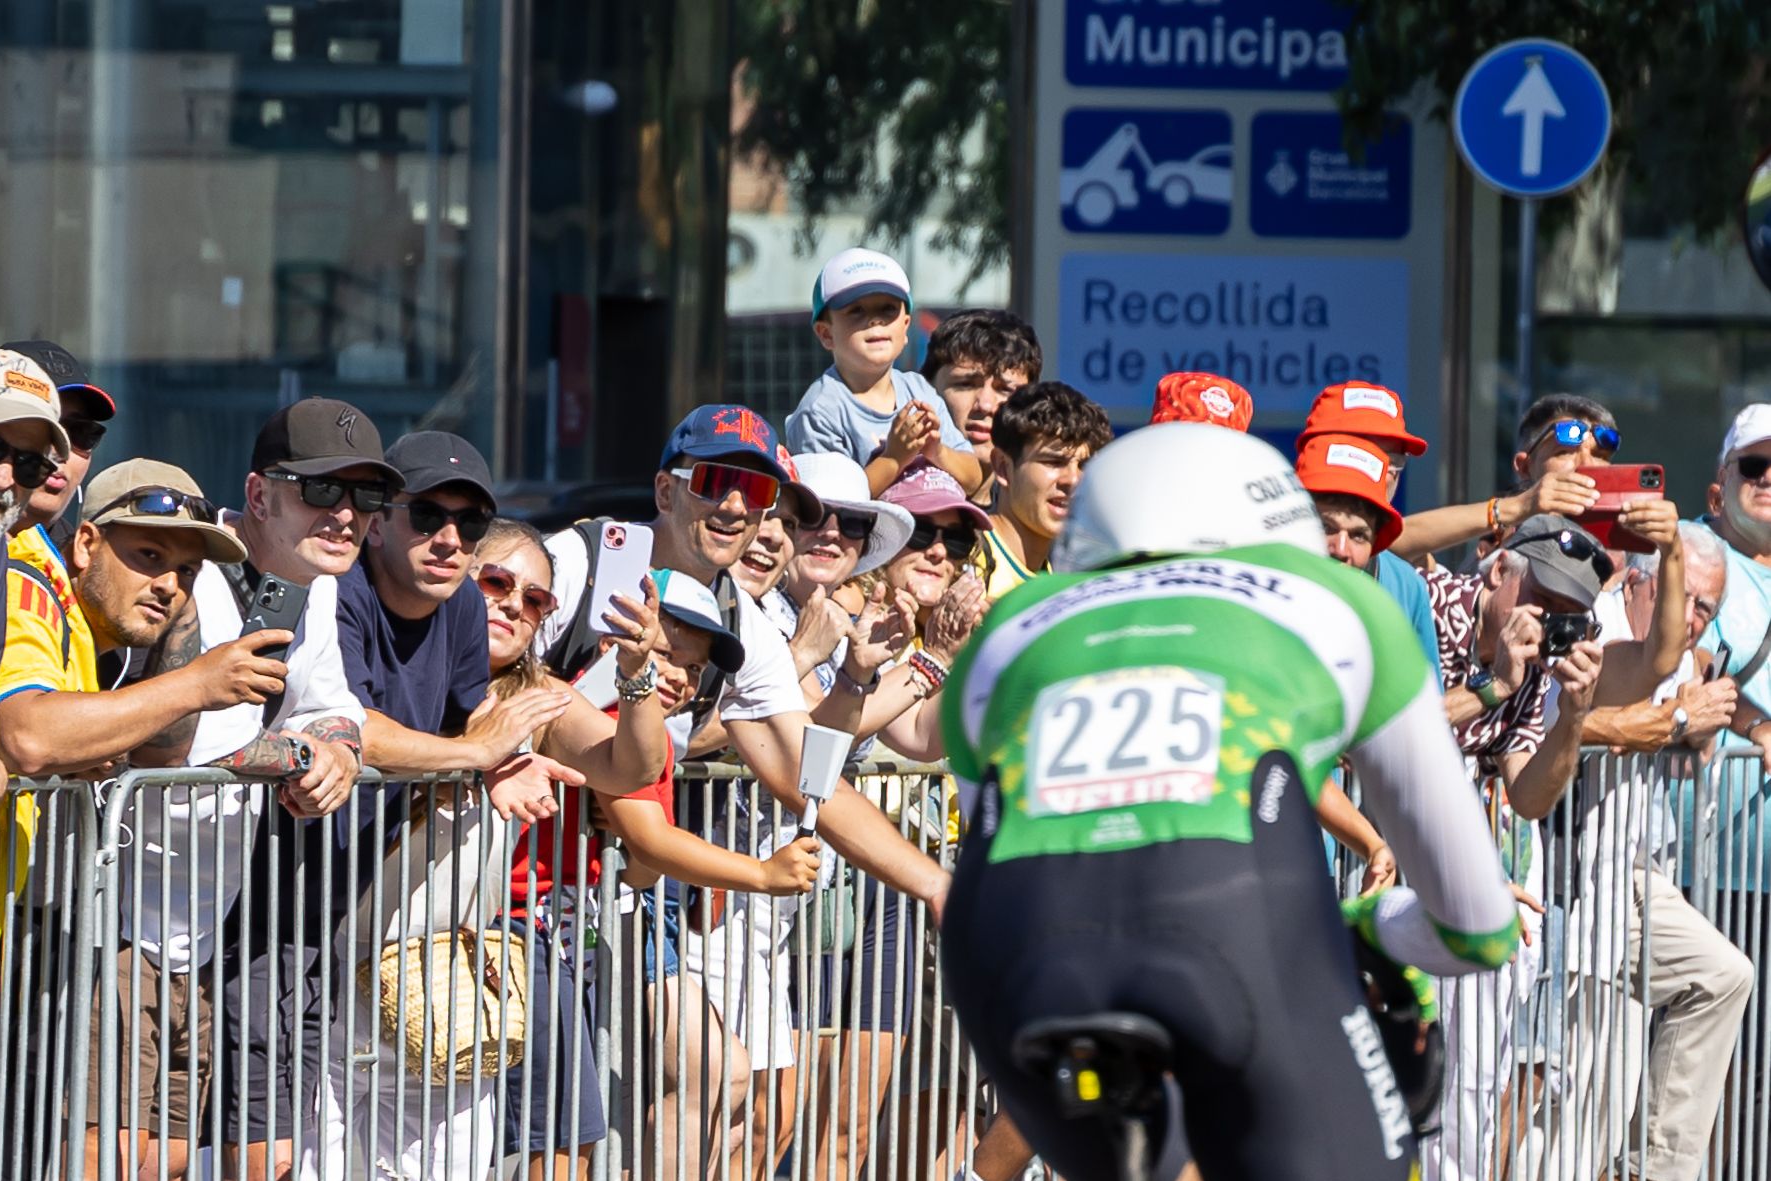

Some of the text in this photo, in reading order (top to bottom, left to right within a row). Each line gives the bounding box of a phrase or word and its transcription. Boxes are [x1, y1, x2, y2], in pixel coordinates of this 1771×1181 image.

[1086, 14, 1350, 78] Municipa
[1083, 279, 1330, 328] Recollida
[1082, 338, 1381, 388] de vehicles
[1045, 686, 1212, 778] 225
